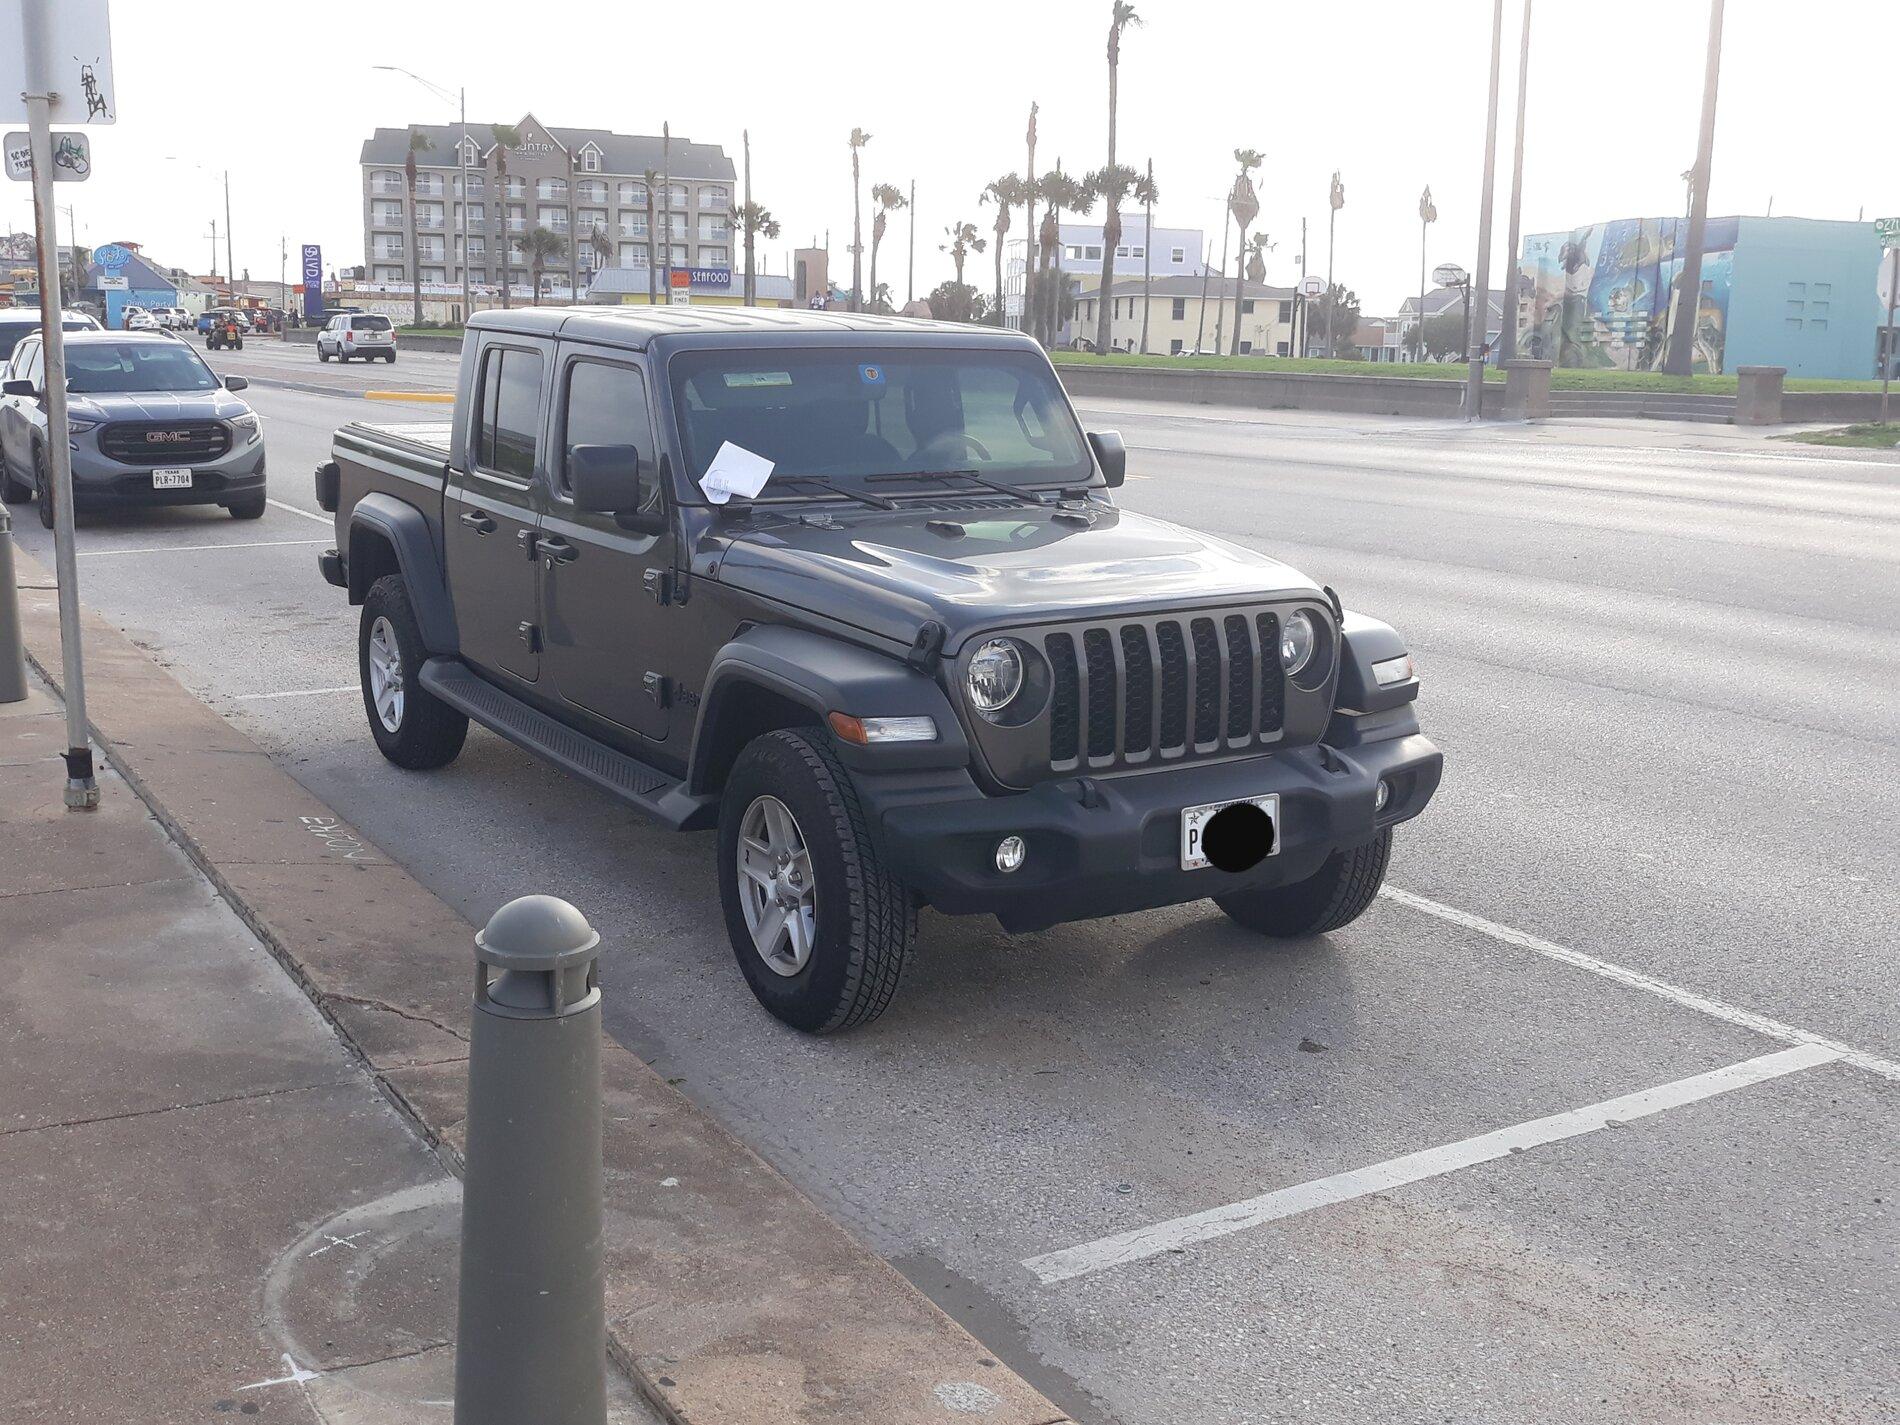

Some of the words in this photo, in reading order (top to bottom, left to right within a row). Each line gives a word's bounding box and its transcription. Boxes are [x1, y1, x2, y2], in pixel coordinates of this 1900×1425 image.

[304, 246, 319, 279] BLVD.
[692, 271, 729, 283] SEAFOOD
[146, 430, 191, 442] GMC
